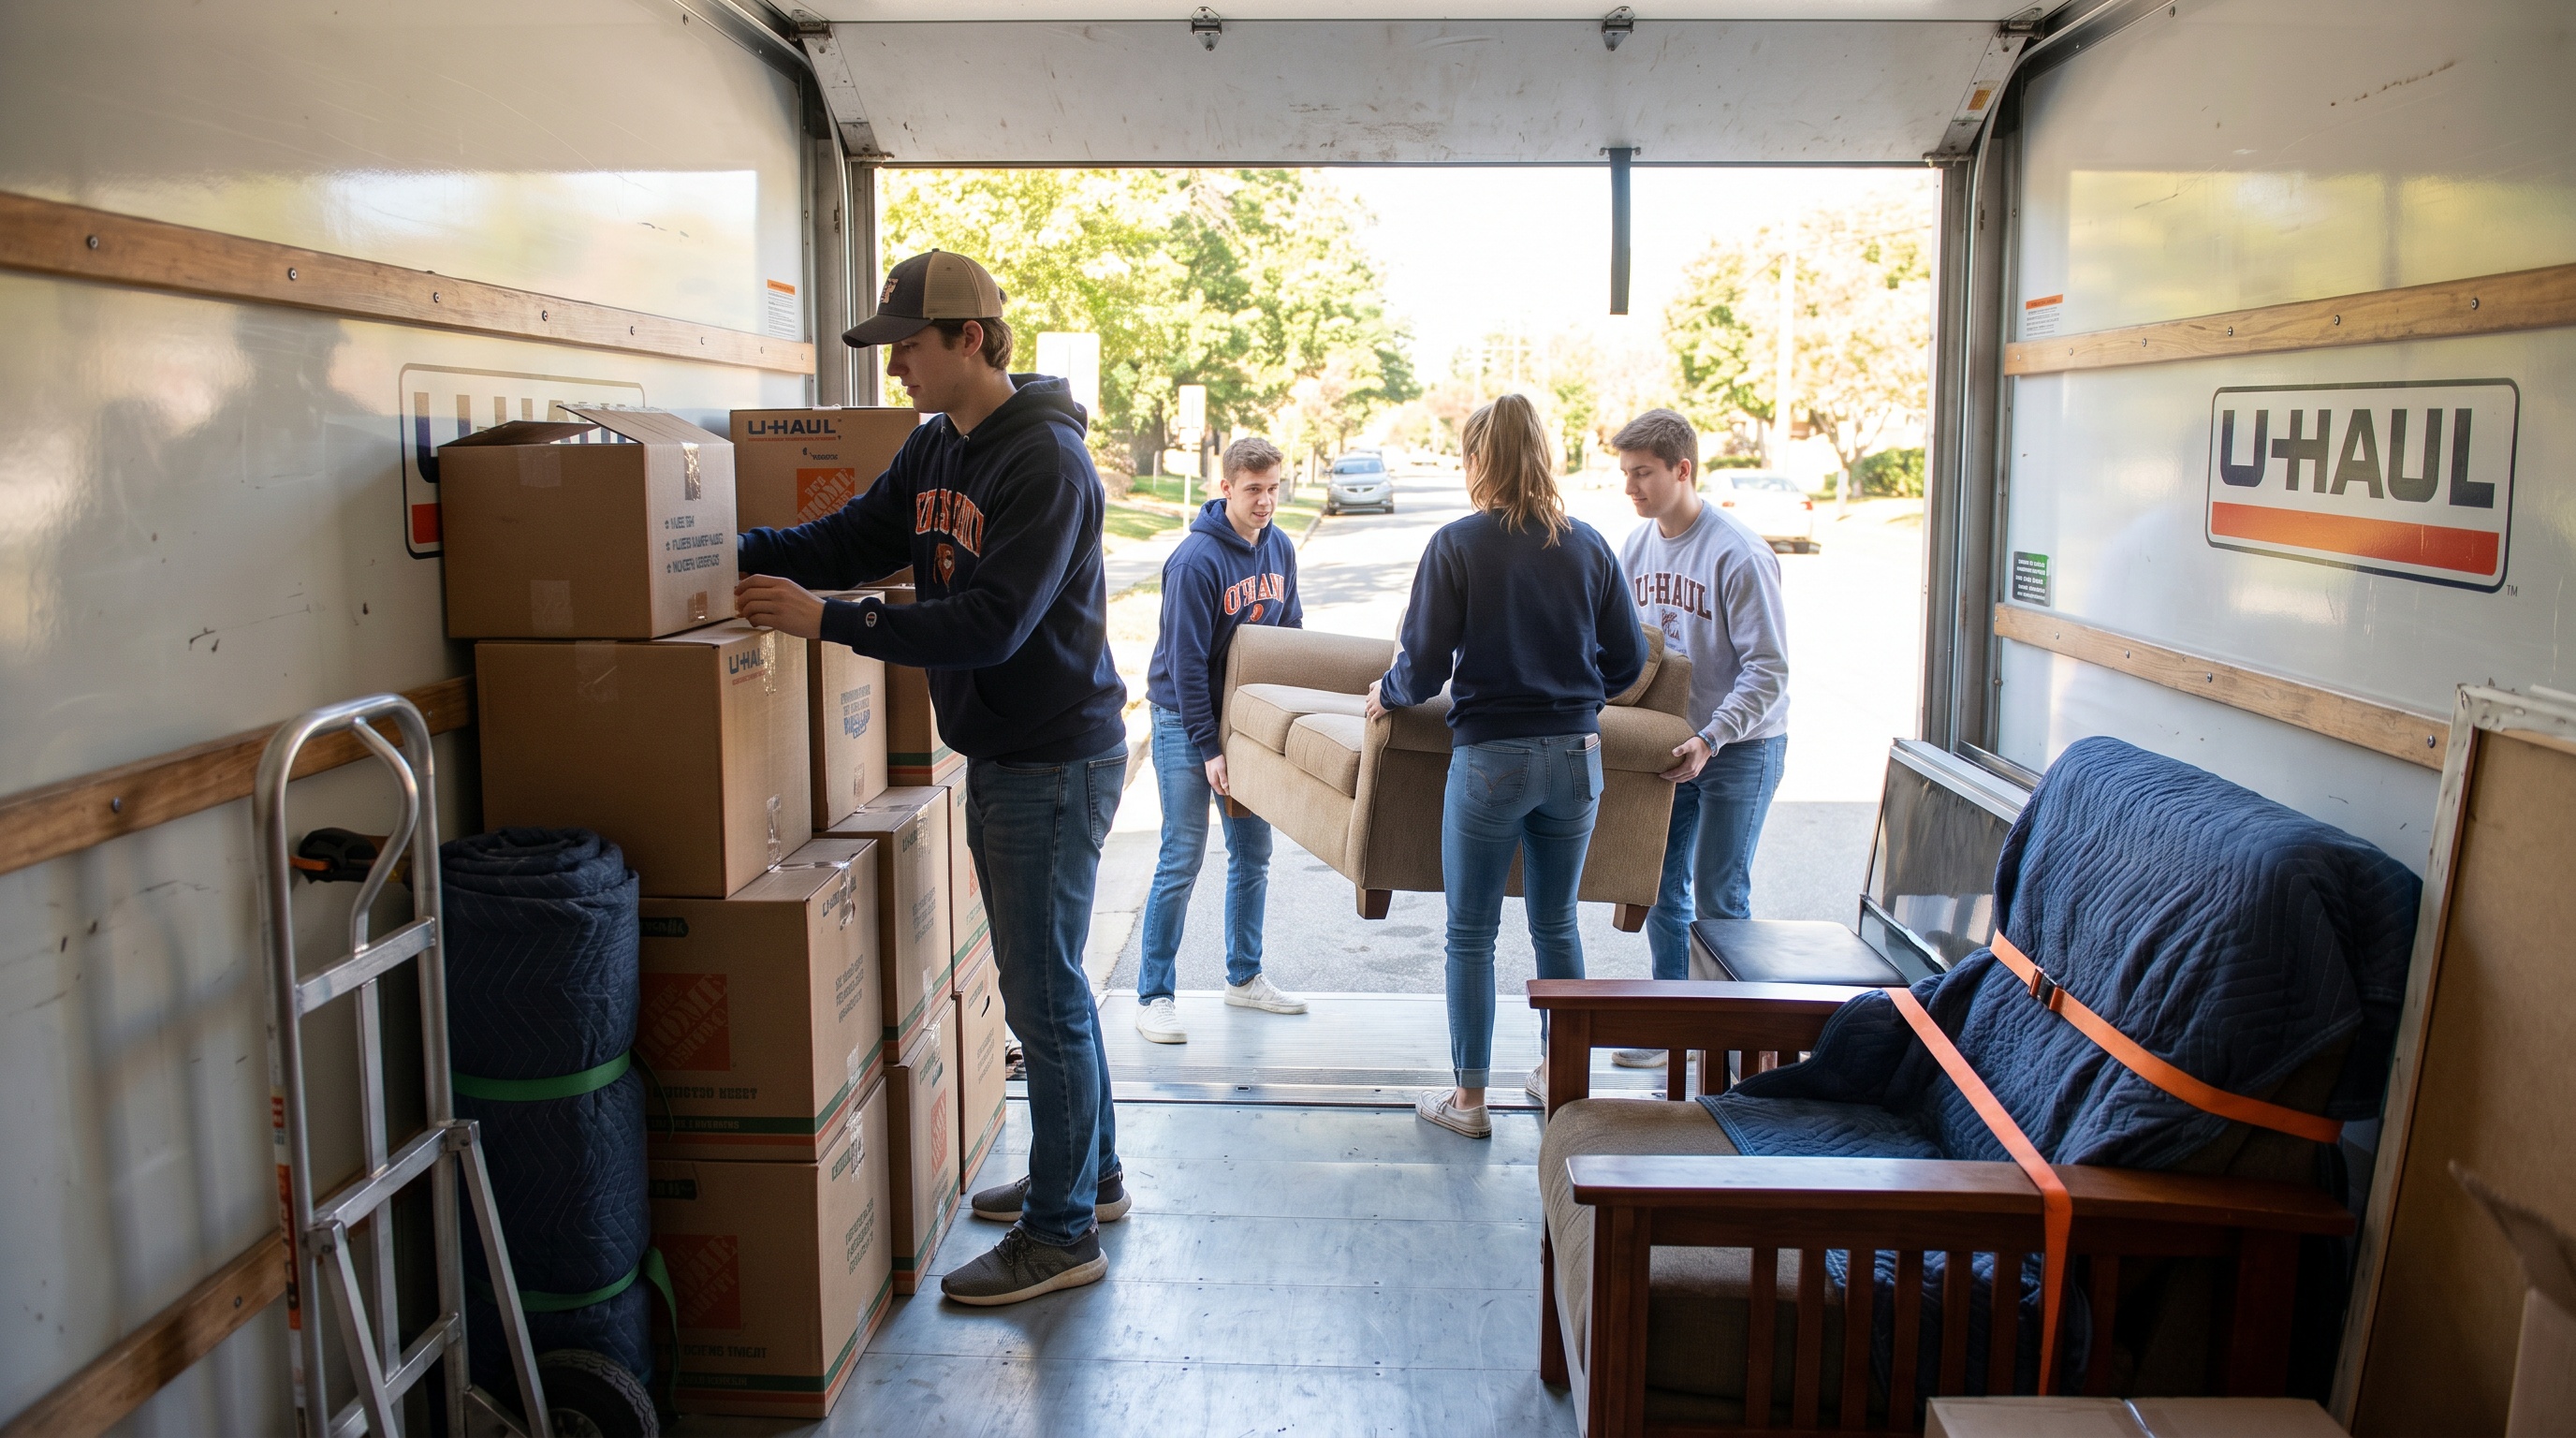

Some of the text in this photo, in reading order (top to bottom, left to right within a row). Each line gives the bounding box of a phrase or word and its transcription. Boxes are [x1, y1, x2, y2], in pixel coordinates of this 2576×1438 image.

[748, 419, 837, 434] U-HAUL
[2219, 408, 2496, 508] U-HAUL
[1635, 573, 1713, 621] U-HAUL
